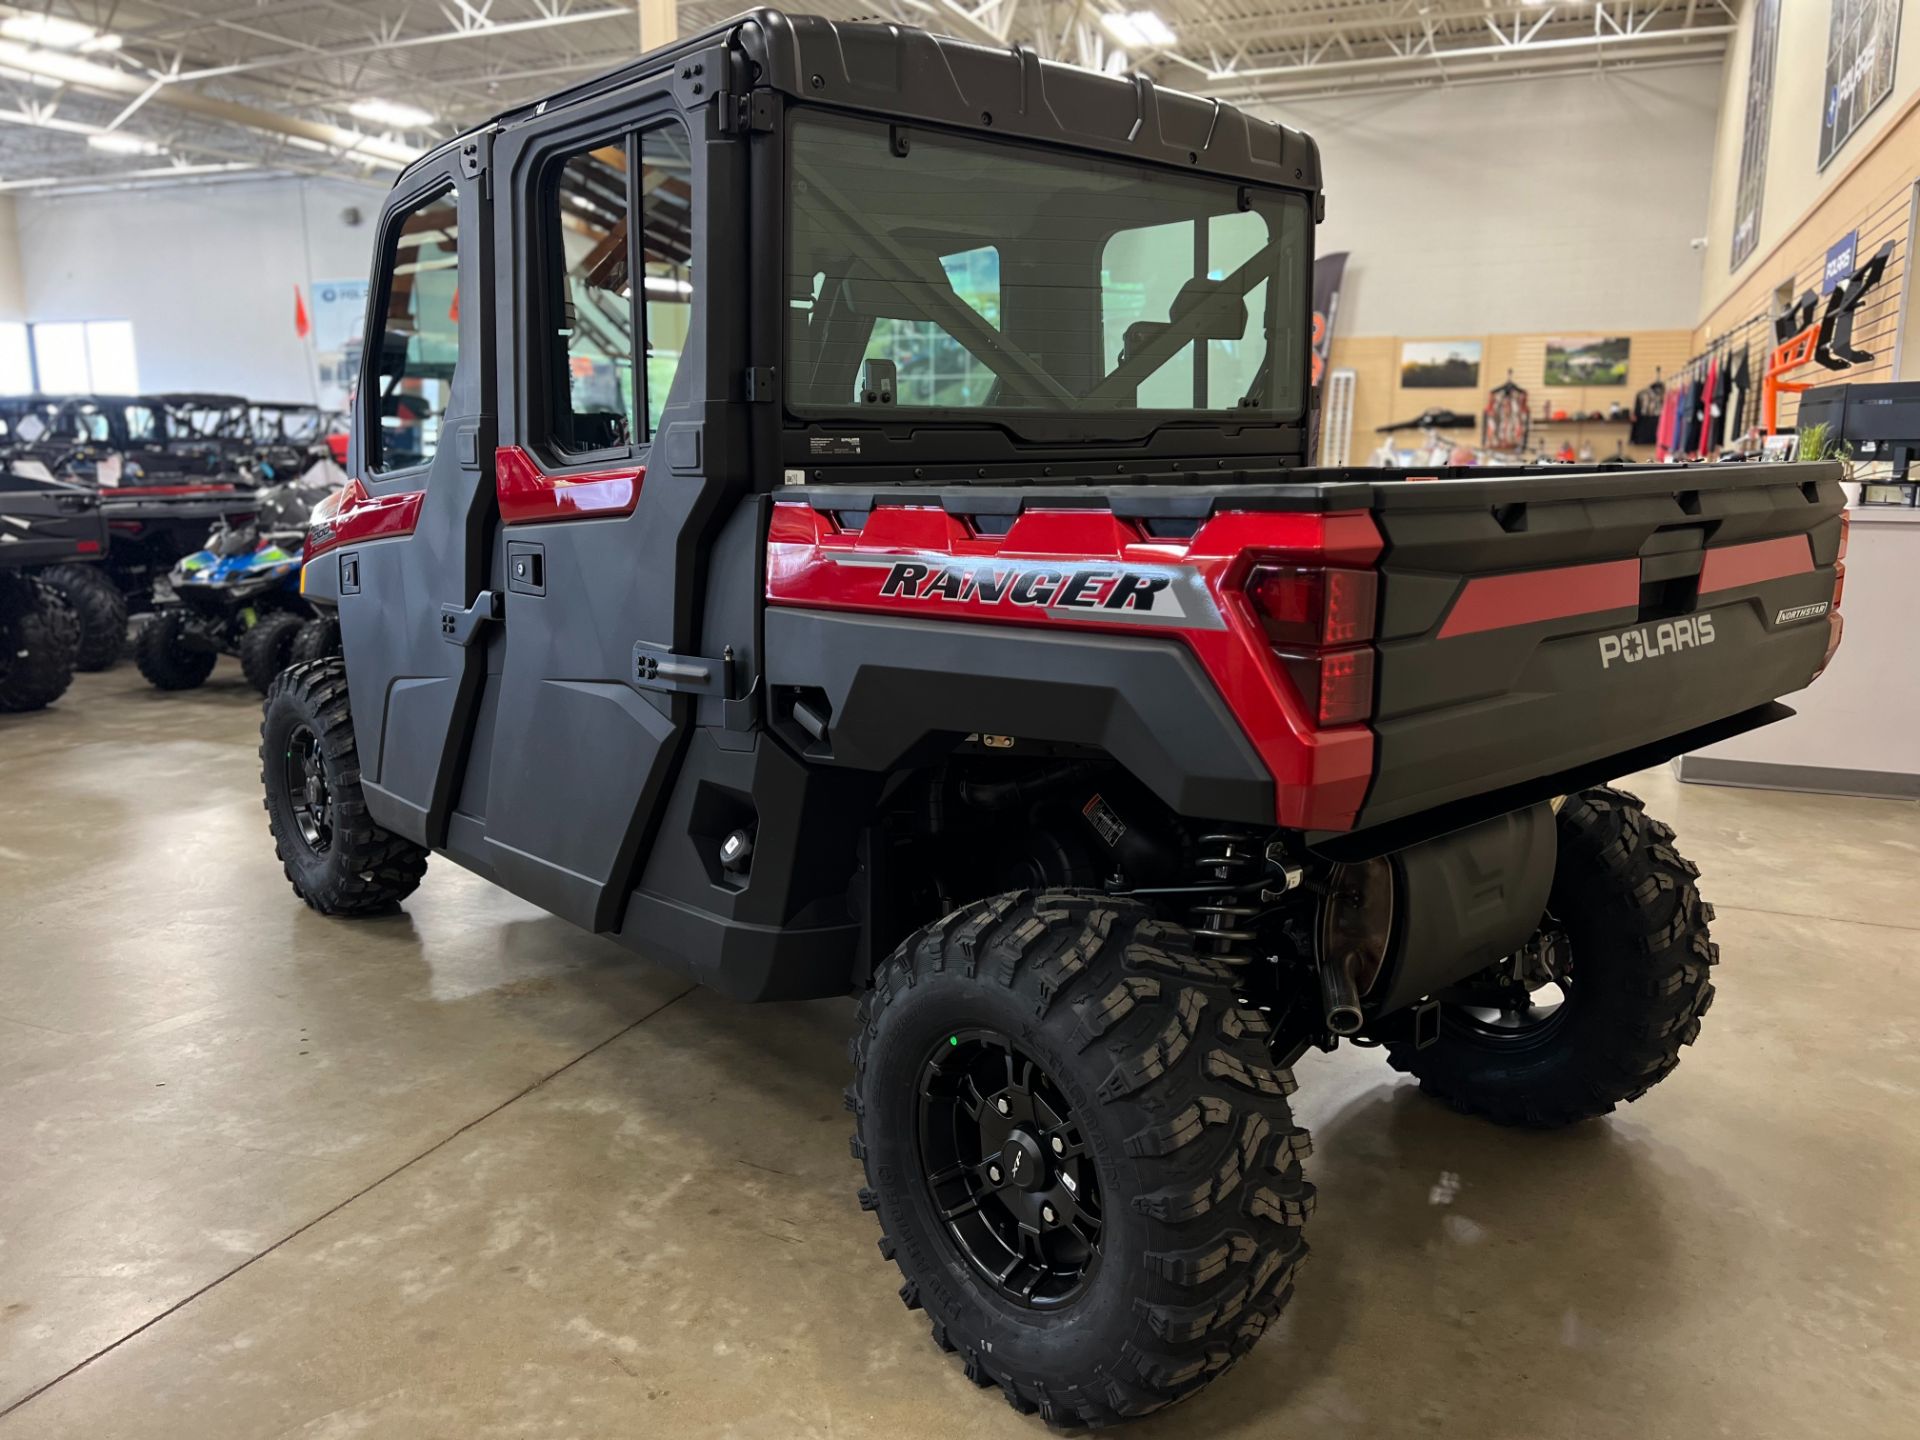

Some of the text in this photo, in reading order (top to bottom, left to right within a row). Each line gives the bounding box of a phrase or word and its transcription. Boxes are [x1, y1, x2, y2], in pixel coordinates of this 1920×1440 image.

[879, 562, 1172, 612] RANGER
[1780, 604, 1826, 622] NORTHSTAR
[1598, 614, 1716, 669] POLARIS
